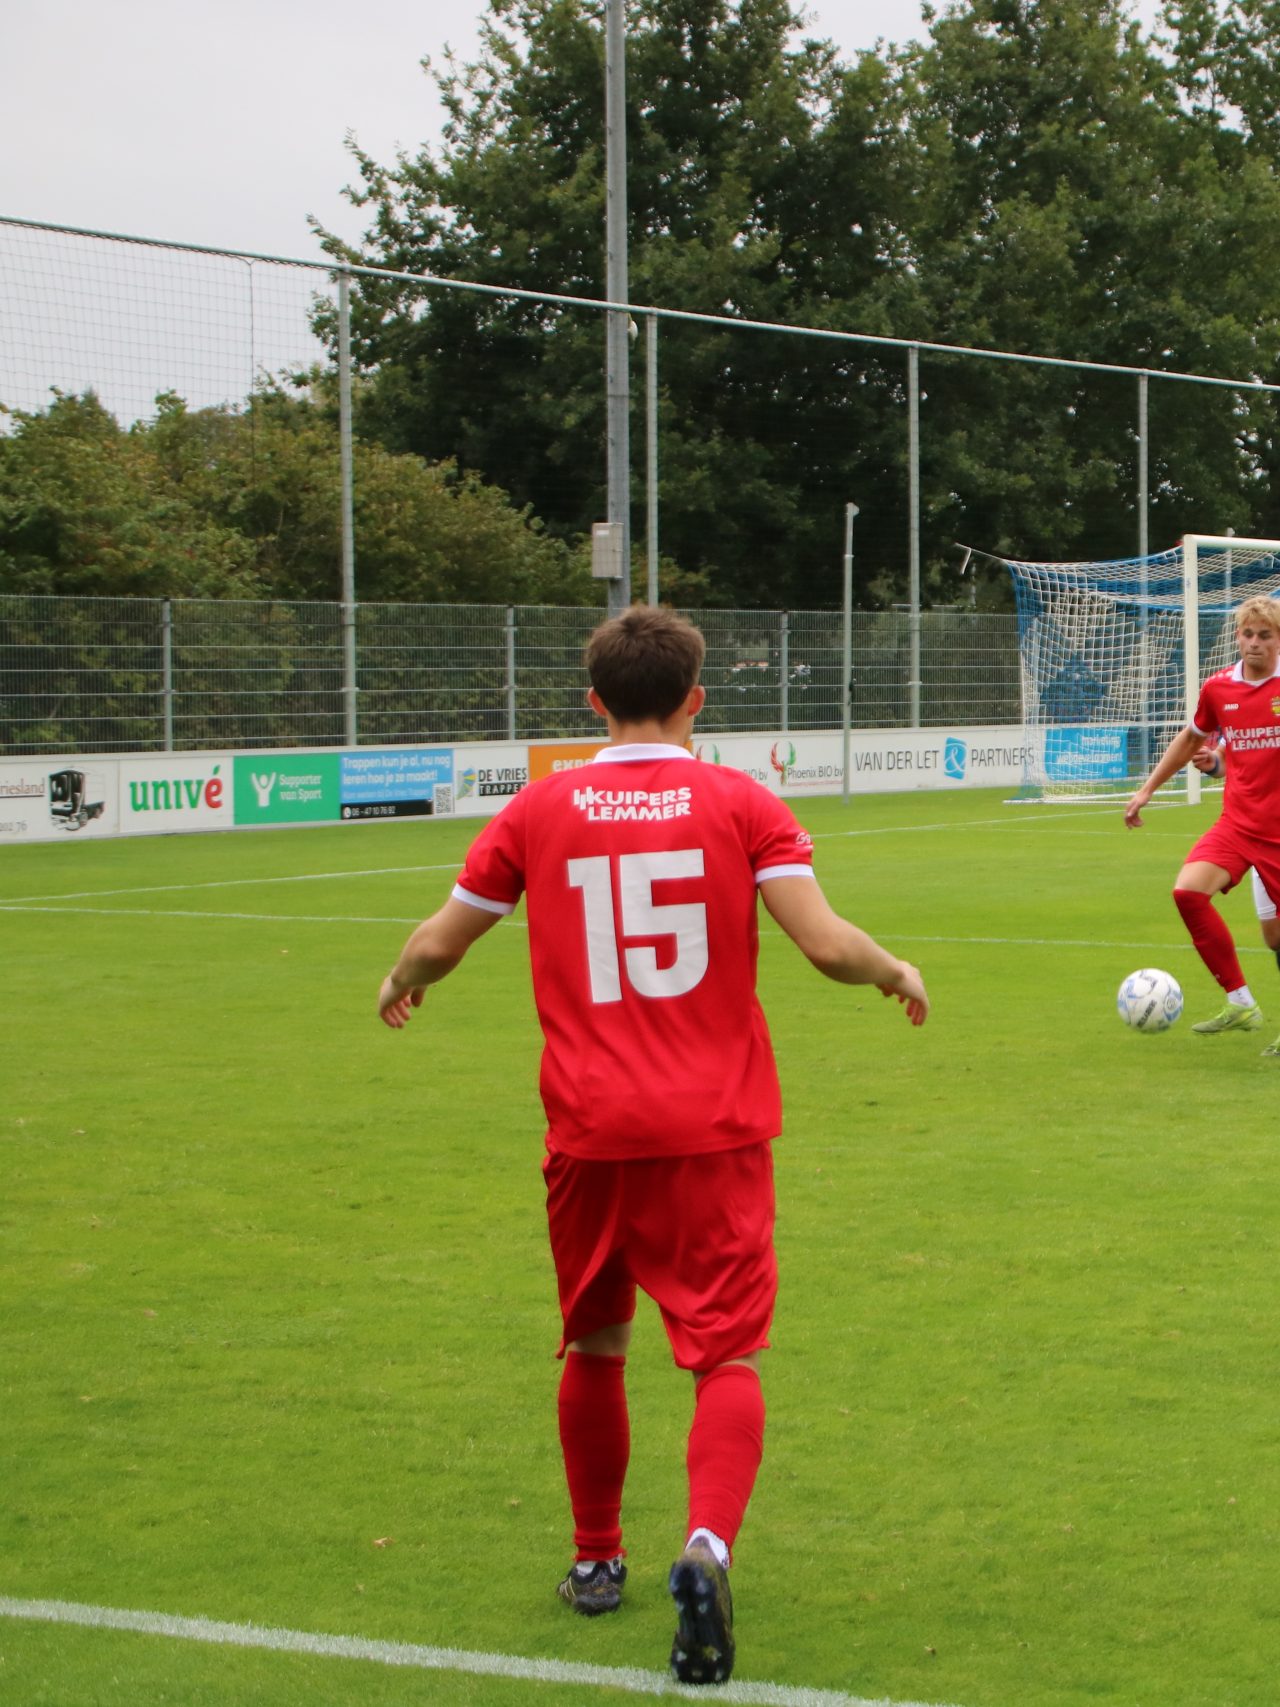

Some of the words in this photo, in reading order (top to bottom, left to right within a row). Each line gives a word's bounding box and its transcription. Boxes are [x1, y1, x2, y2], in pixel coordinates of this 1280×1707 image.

[342, 757, 381, 772] Trappen
[382, 756, 399, 767] kun
[855, 750, 882, 772] VAN
[887, 750, 913, 770] DER
[917, 749, 940, 769] LET
[971, 747, 1035, 768] PARTNERS
[367, 772, 384, 783] hoe
[478, 769, 493, 782] DE
[496, 767, 527, 781] VRIES
[787, 767, 816, 780] Phoenix
[818, 765, 833, 778] BIO
[129, 764, 223, 812] univé
[279, 774, 322, 789] Supporter
[280, 790, 297, 801] van
[298, 789, 322, 803] Sport
[586, 786, 692, 807] KUIPERS
[587, 802, 692, 822] LEMMER
[567, 849, 710, 1004] 15
